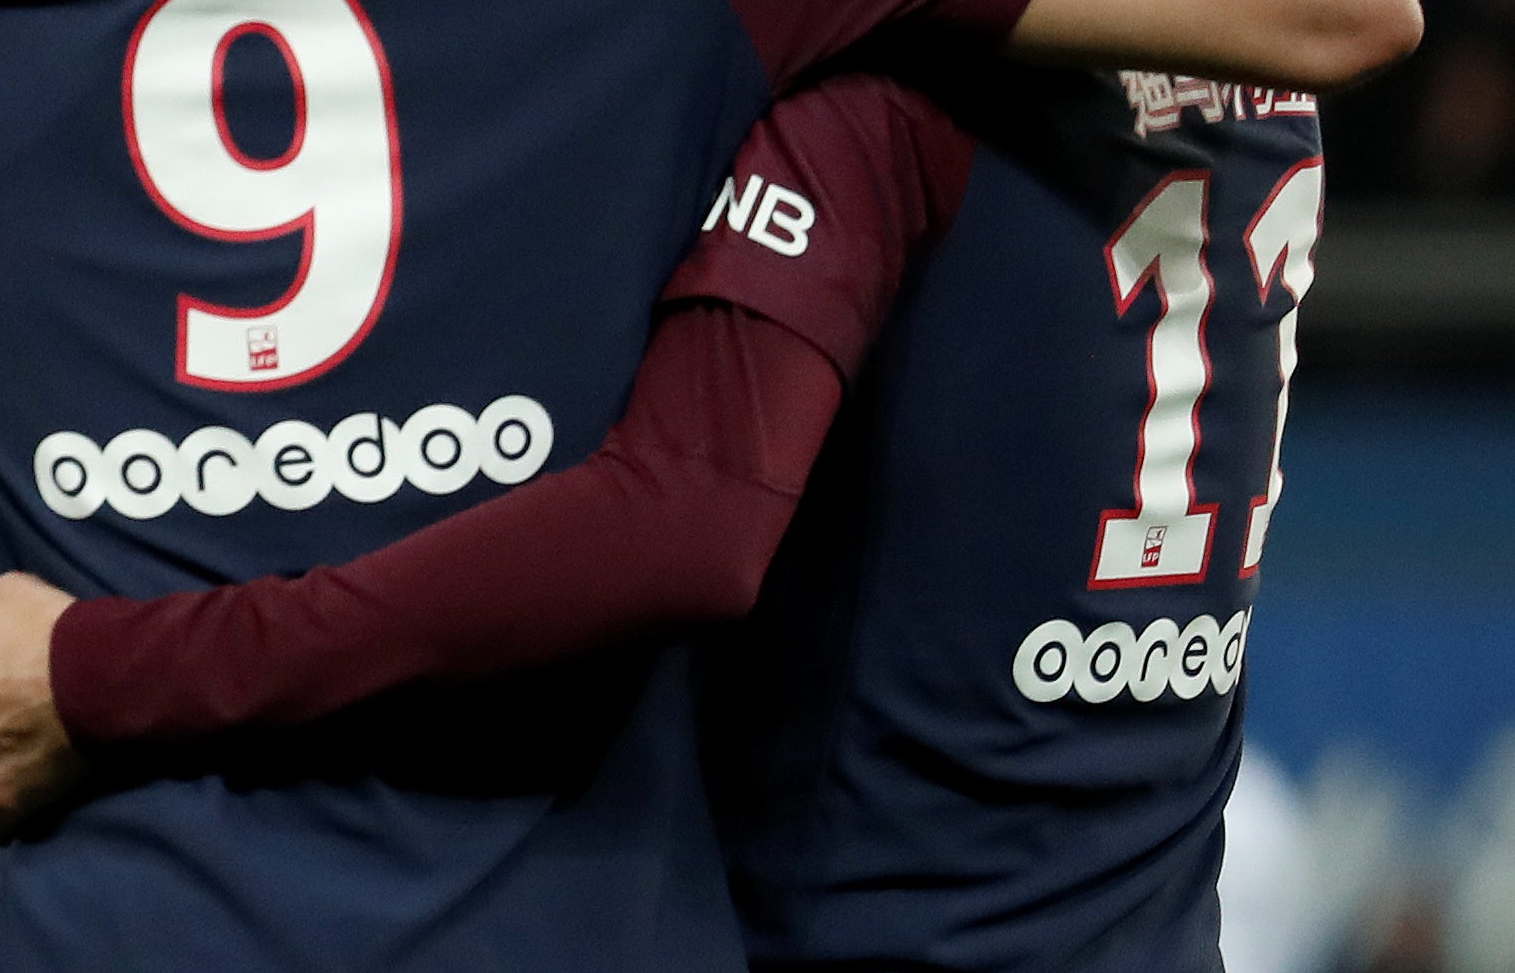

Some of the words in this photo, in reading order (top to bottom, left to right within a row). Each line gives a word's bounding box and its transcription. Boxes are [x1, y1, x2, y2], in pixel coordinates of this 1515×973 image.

[700, 173, 816, 258] NB
[1086, 154, 1324, 591] 11
[38, 400, 548, 514] ooredoo
